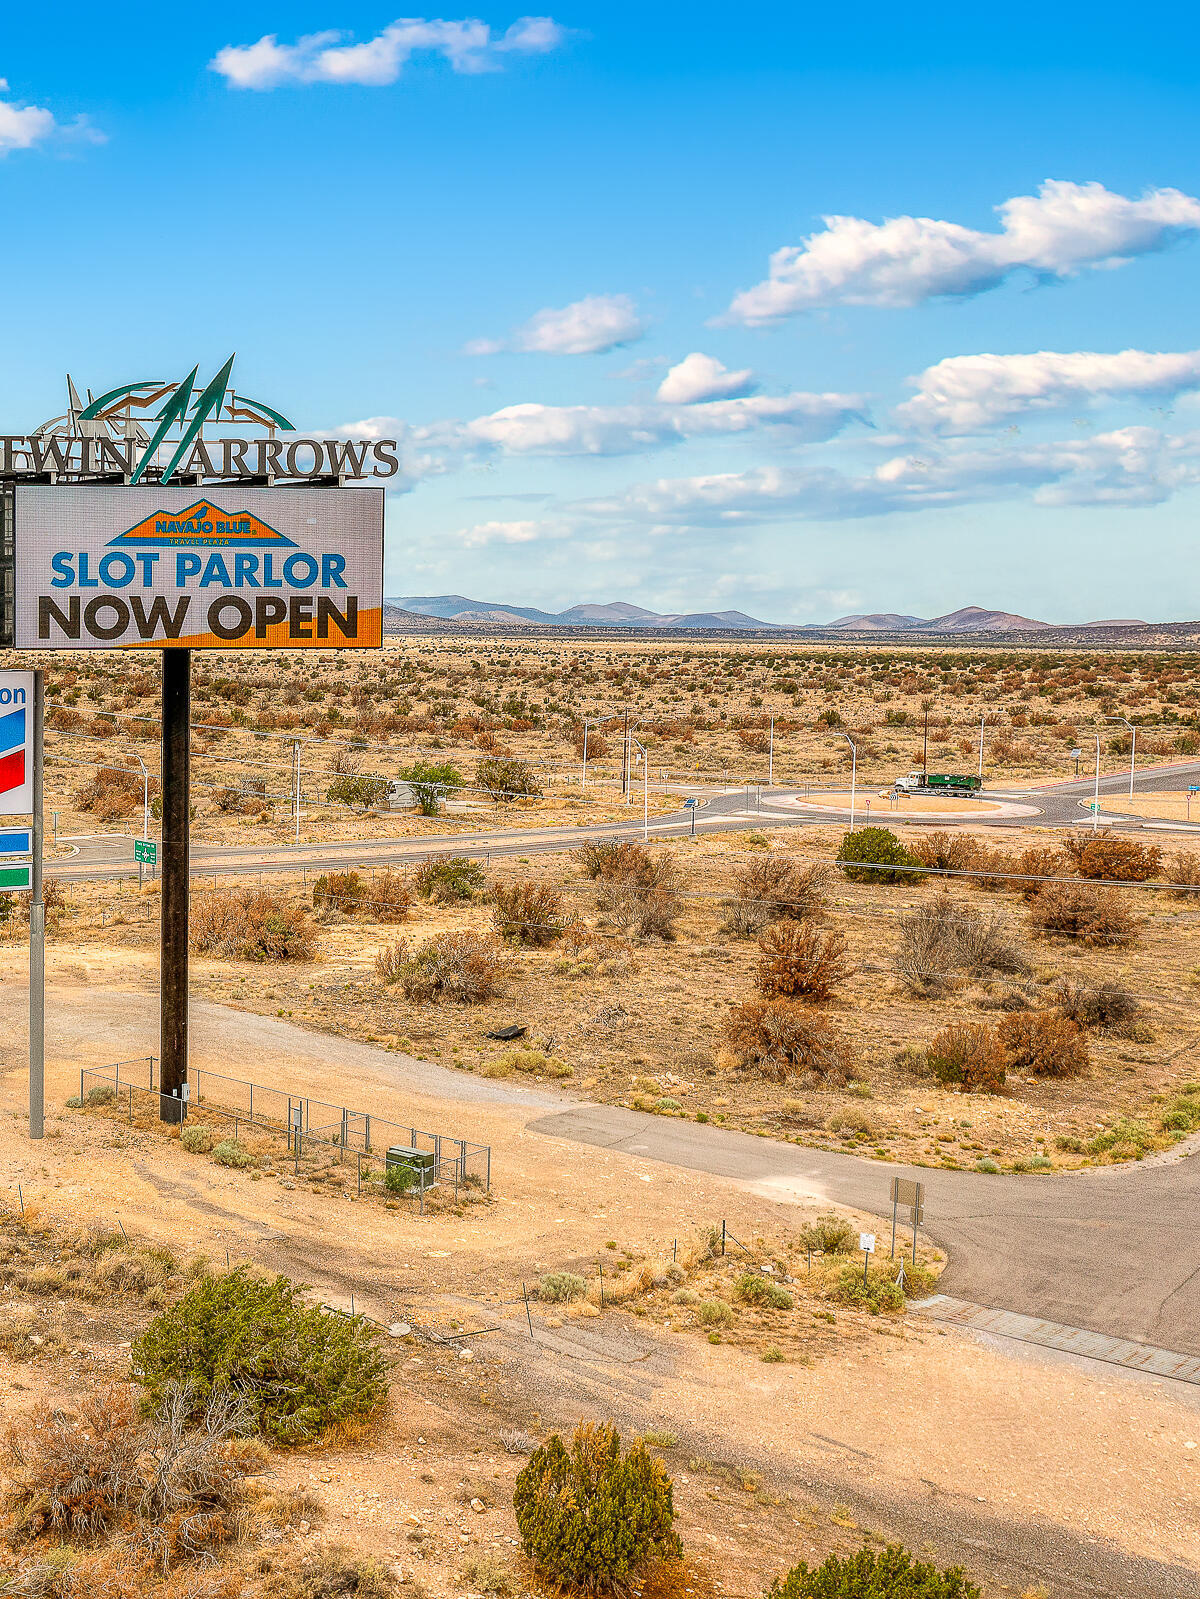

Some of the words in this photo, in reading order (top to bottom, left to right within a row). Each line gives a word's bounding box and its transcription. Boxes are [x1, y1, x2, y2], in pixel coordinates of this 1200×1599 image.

[183, 438, 399, 477] ARROWS
[156, 521, 213, 534] NAVAJO
[50, 551, 160, 588] SLOT
[176, 552, 348, 588] PARLOR
[39, 595, 191, 640] NOW
[207, 595, 358, 640] OPEN
